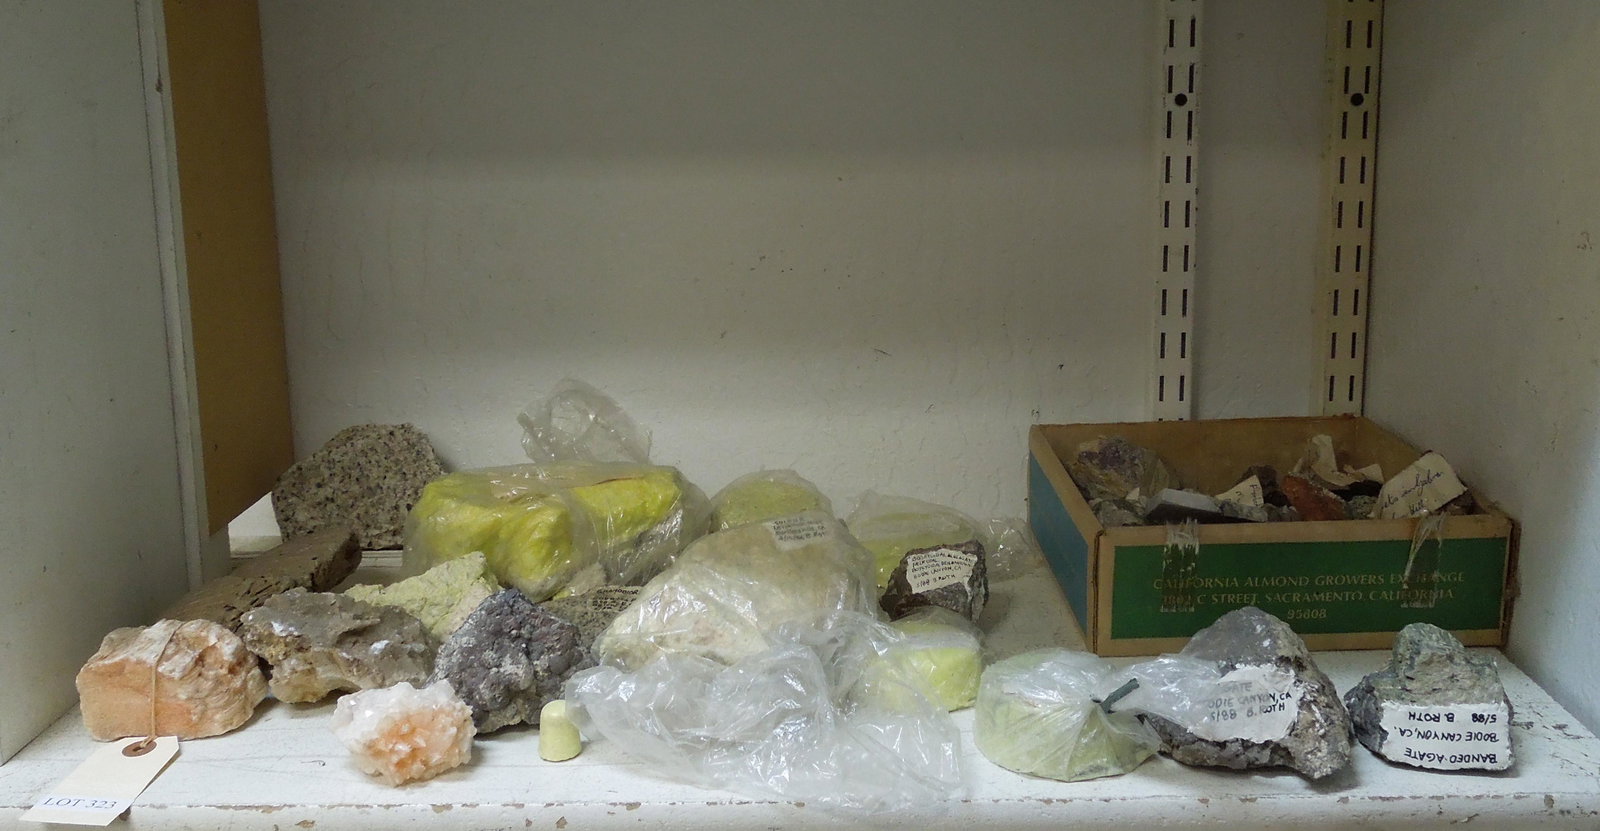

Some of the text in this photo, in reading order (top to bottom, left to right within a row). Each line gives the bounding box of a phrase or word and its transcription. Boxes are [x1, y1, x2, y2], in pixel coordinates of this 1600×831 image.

[1153, 572, 1465, 590] CALIFORNIA ALMOND GROWERS EXHANGE
[1197, 594, 1206, 605] C
[1369, 589, 1457, 601] CALIFORNIA
[1287, 608, 1328, 620] 95808
[1220, 681, 1253, 694] GATE
[1207, 697, 1234, 709] ODIE
[1259, 701, 1285, 714] ROTH
[1408, 711, 1441, 723] ROTH
[1471, 712, 1497, 725] 5/88
[1464, 730, 1500, 743] BODIE
[1403, 747, 1445, 764] AGATE
[43, 797, 117, 809] LOT 323
